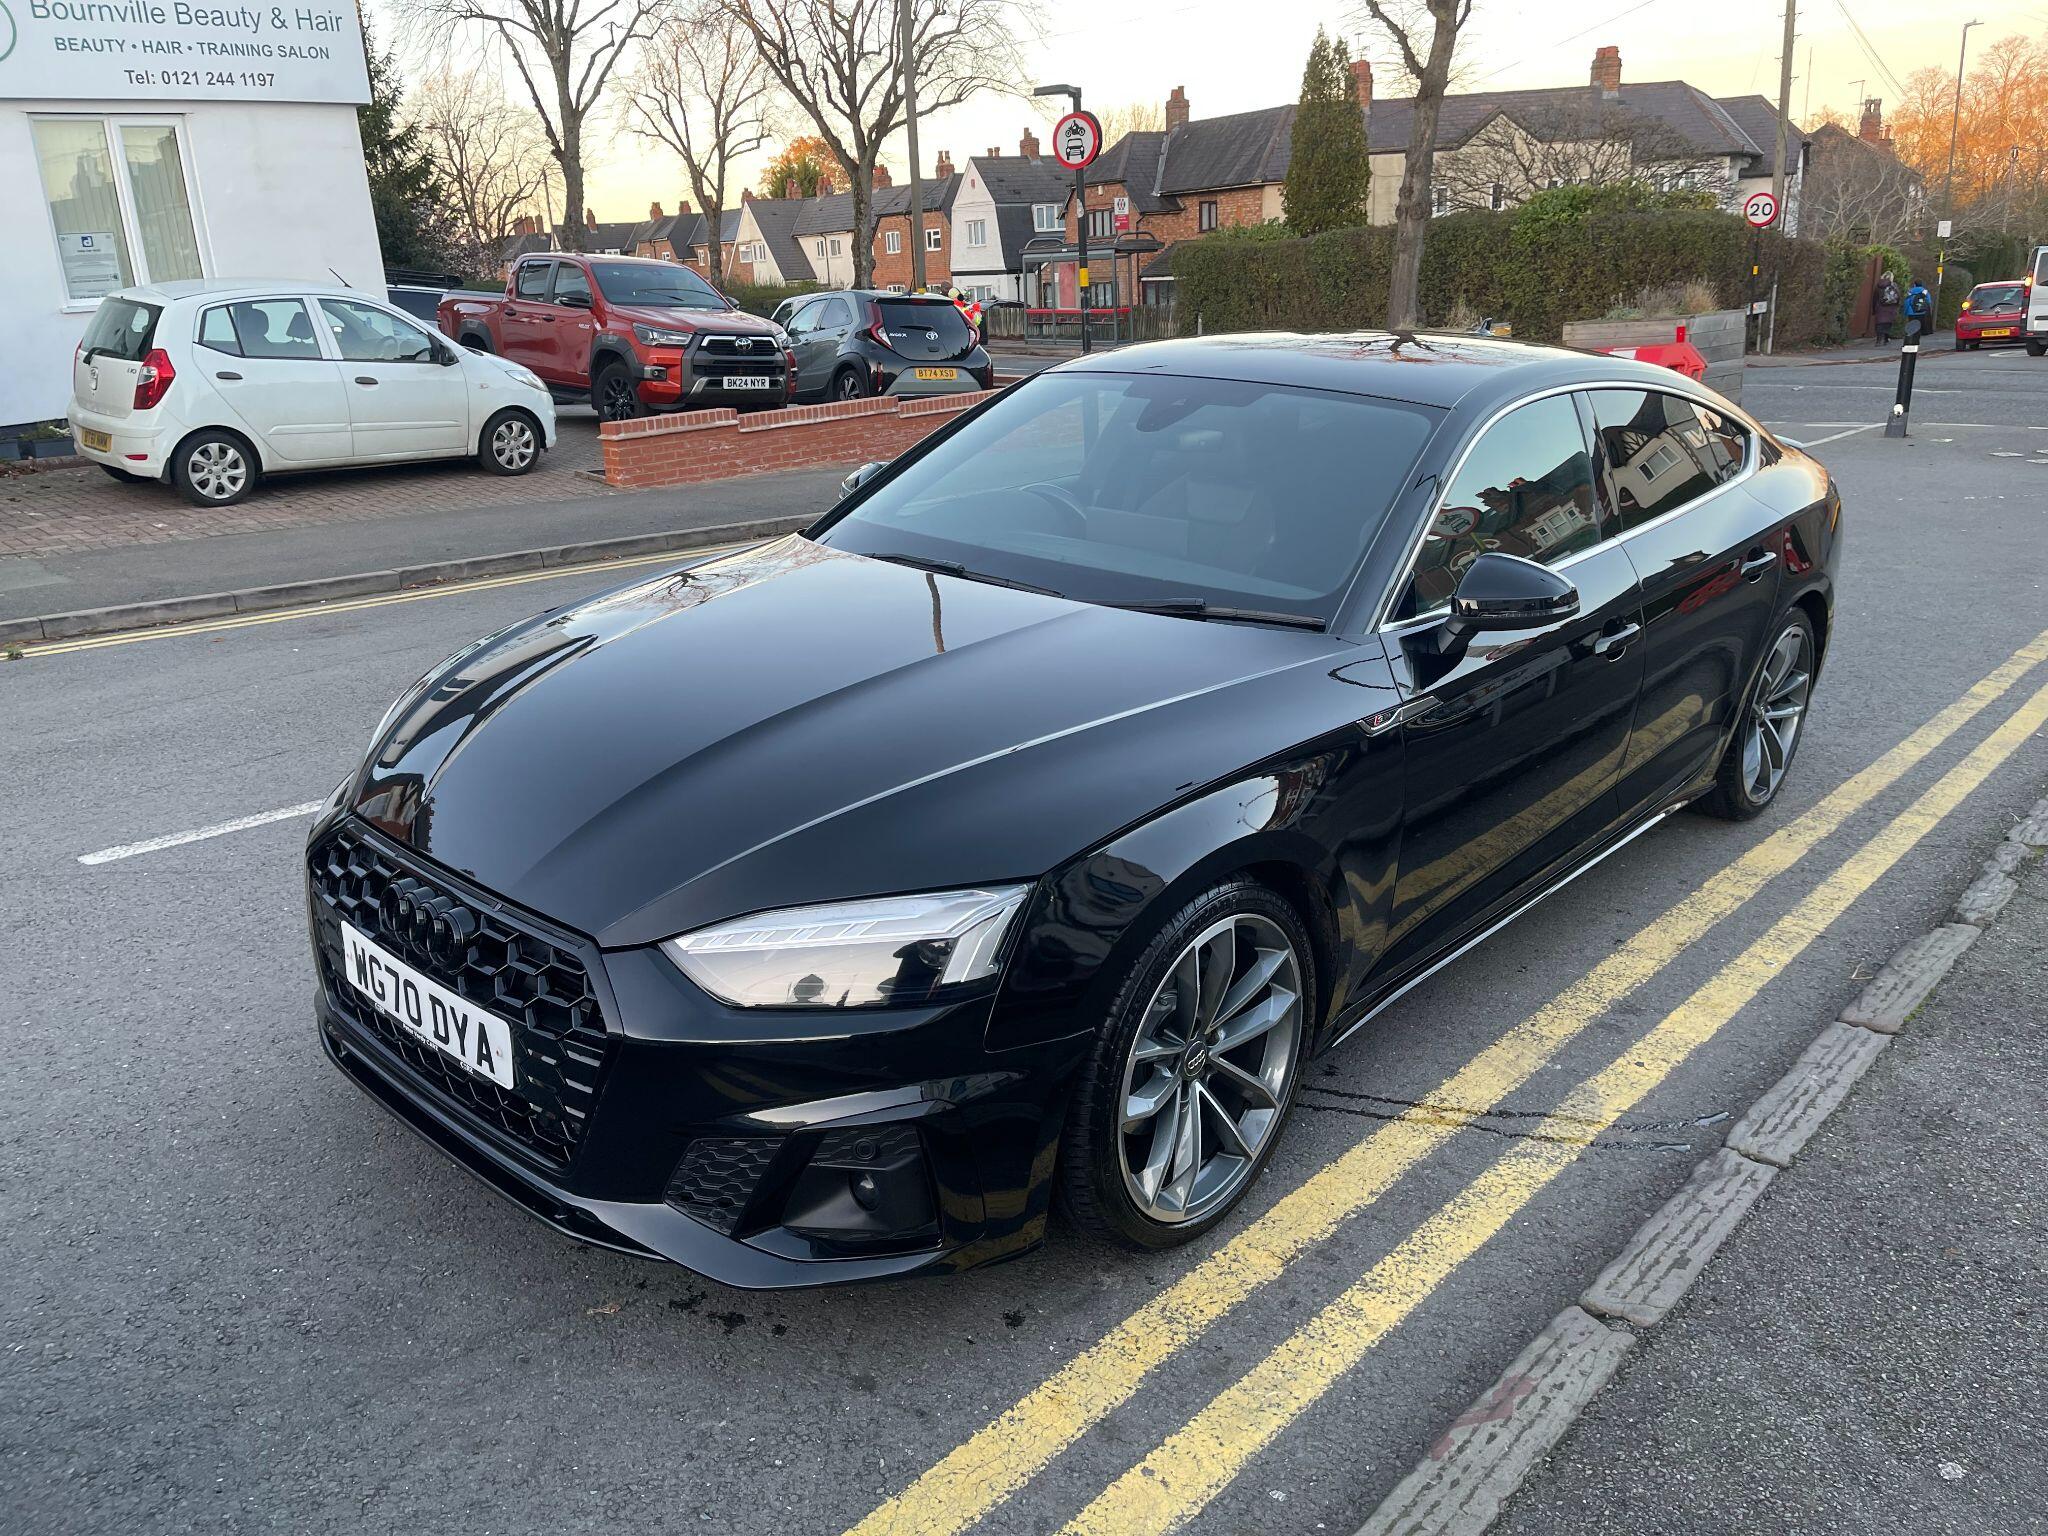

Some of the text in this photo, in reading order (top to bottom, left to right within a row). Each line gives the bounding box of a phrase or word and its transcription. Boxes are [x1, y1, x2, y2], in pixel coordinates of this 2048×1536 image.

[30, 0, 343, 34] Bournville Beauty & Hair
[54, 37, 330, 60] BEAUTY HAIR TRAINING SALON
[123, 69, 275, 87] Tel: 0121 244 1197
[1749, 203, 1773, 216] 20
[727, 378, 766, 388] BK24 NYR
[352, 940, 496, 1076] WG70 DYA
